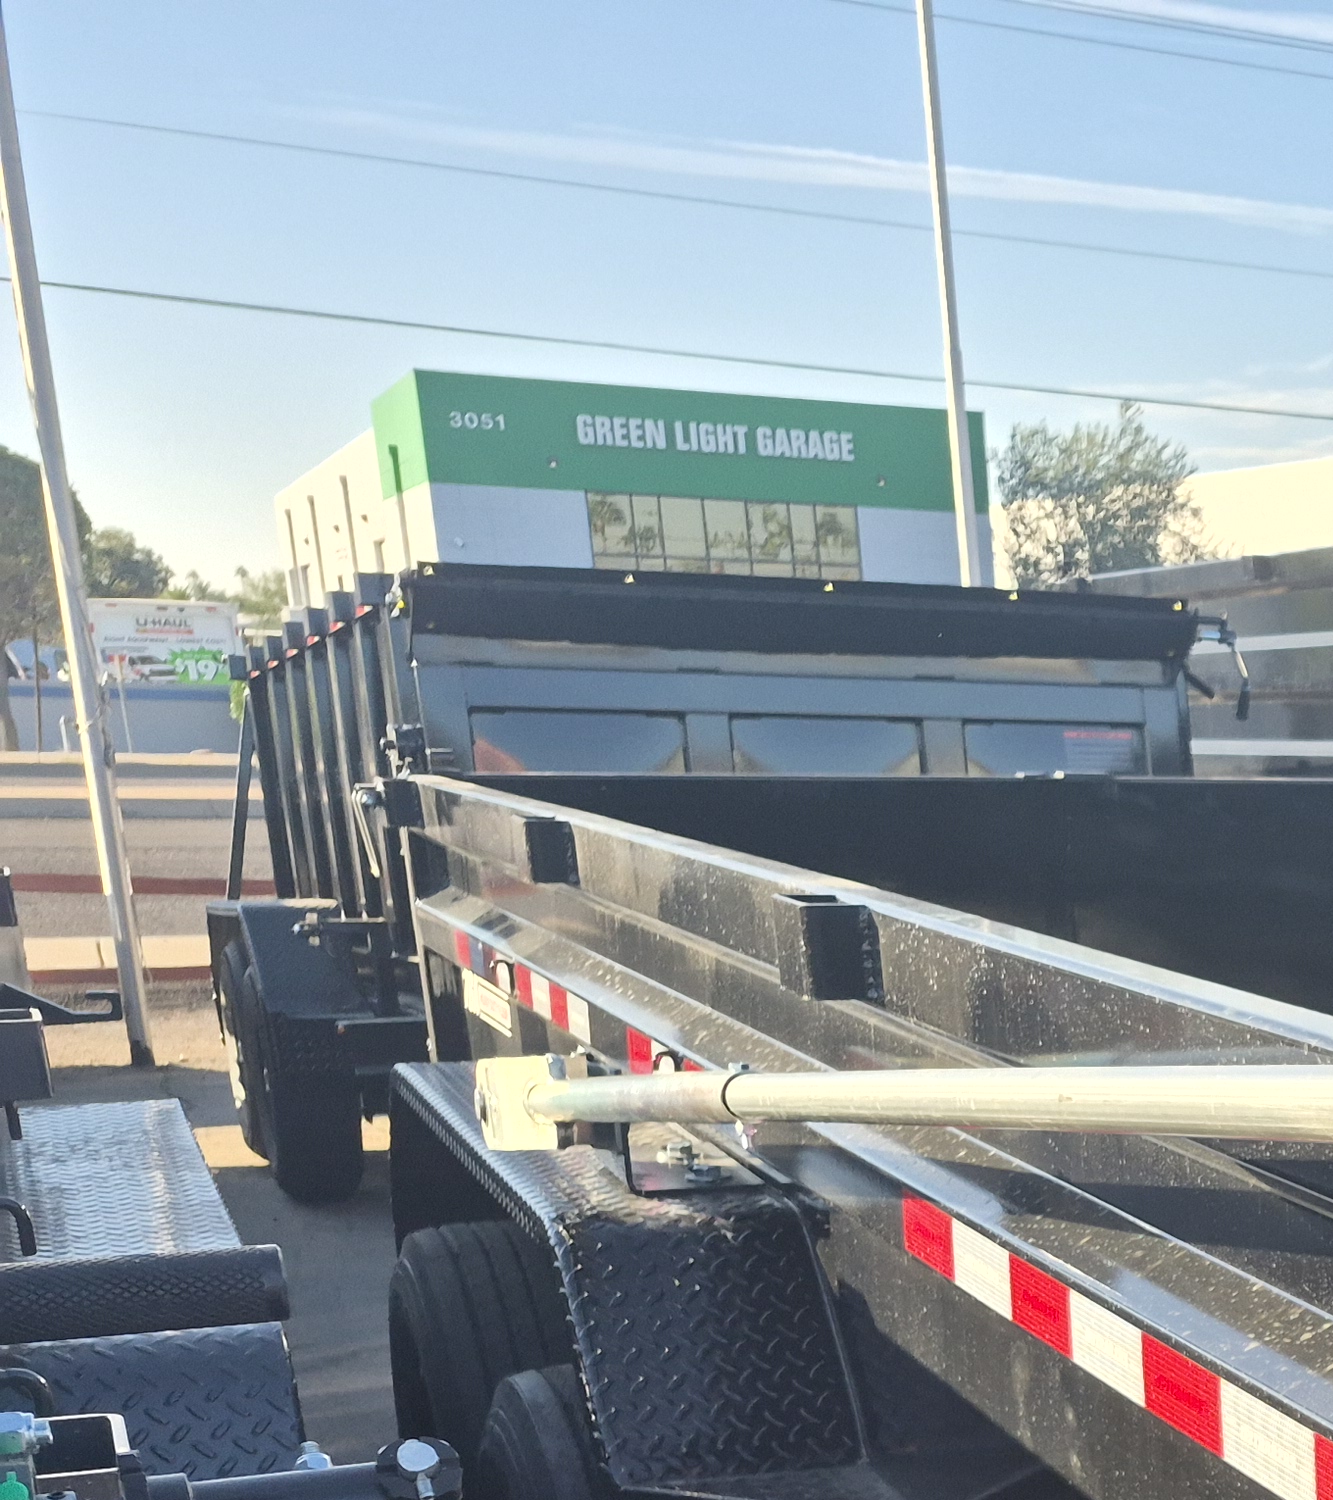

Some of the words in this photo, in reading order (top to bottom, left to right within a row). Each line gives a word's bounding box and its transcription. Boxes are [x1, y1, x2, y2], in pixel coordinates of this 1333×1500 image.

[448, 410, 506, 432] 3051
[575, 413, 667, 450] GREEN
[674, 420, 749, 456] LIGHT
[755, 425, 856, 463] GARAGE
[135, 617, 192, 628] U-HAUL
